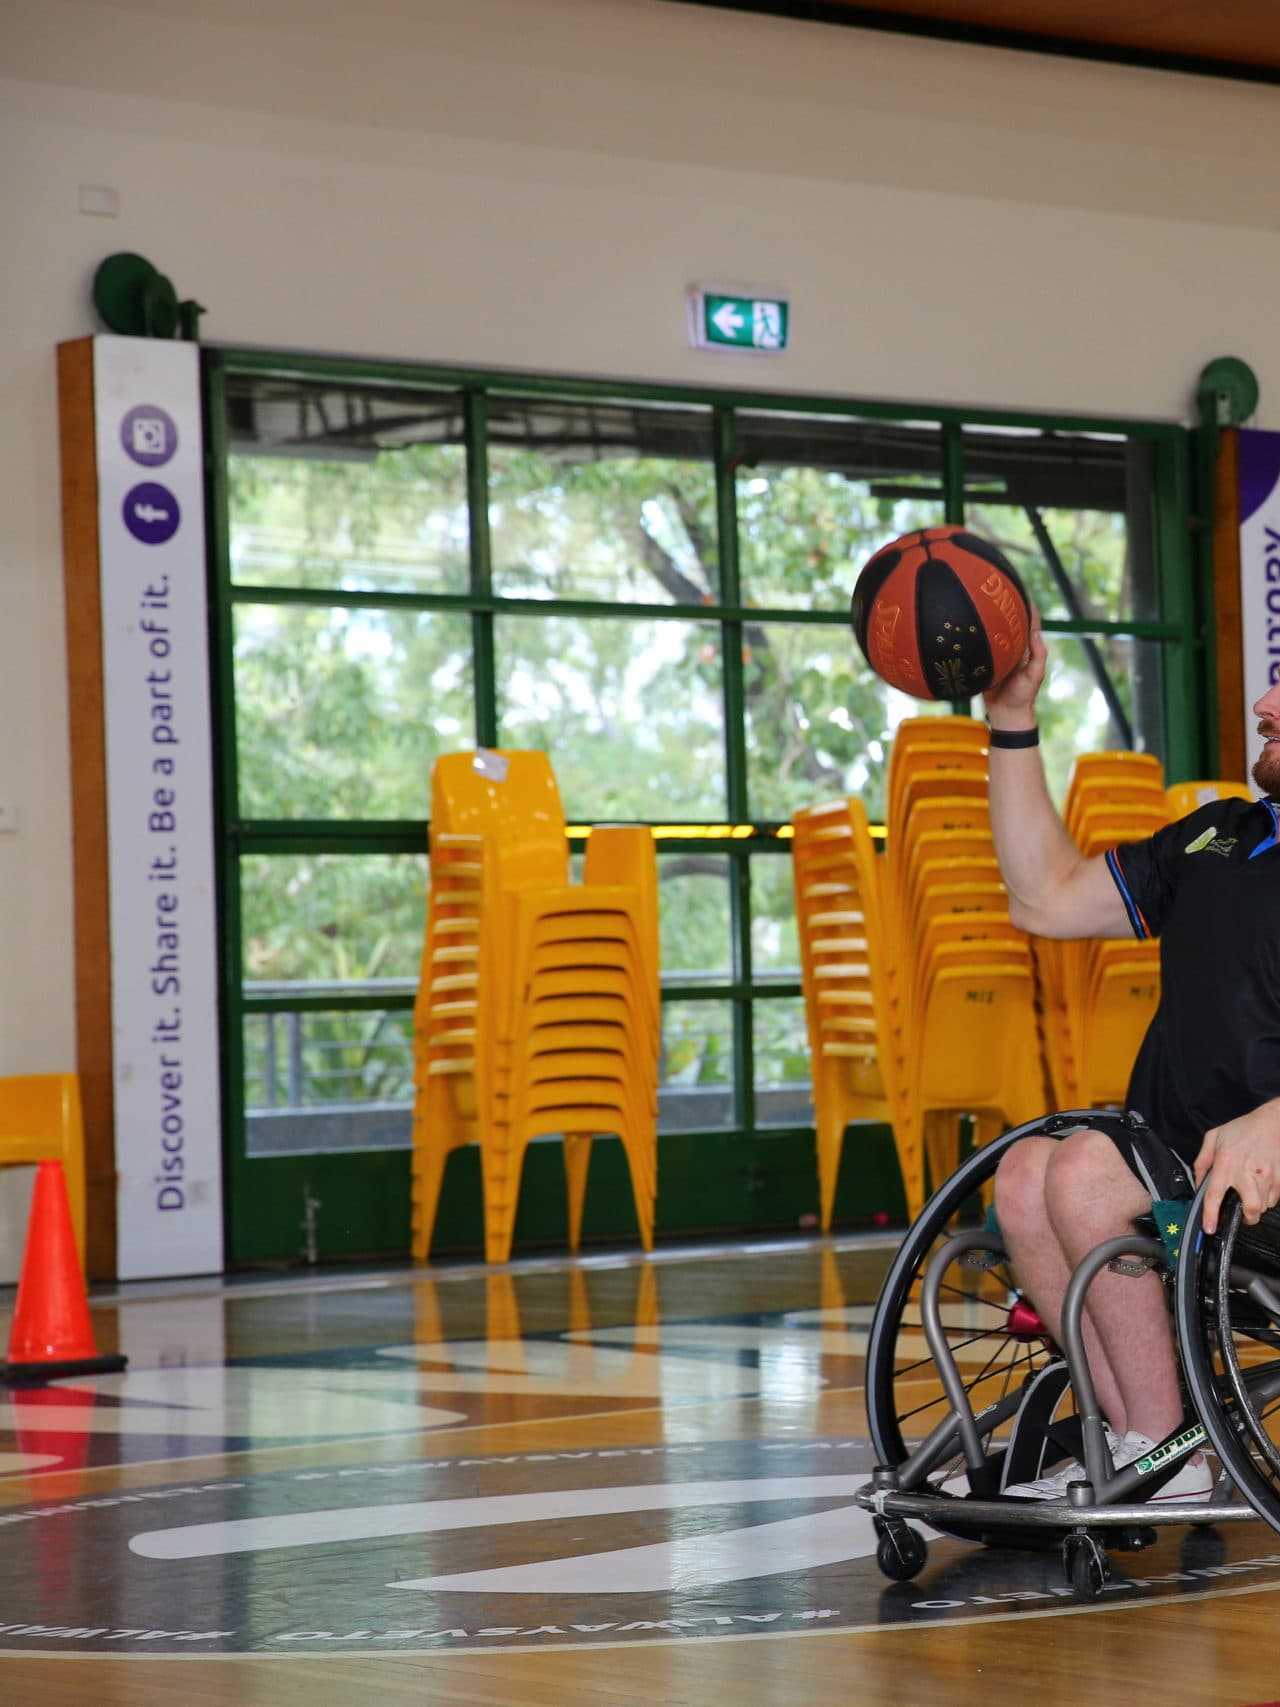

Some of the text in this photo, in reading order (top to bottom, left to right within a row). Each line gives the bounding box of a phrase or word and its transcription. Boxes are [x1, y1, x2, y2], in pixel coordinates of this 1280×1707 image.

[140, 575, 185, 1212] Discover it. Share it. Be a part of it.
[275, 1609, 841, 1641] #ALWAYSVETO
